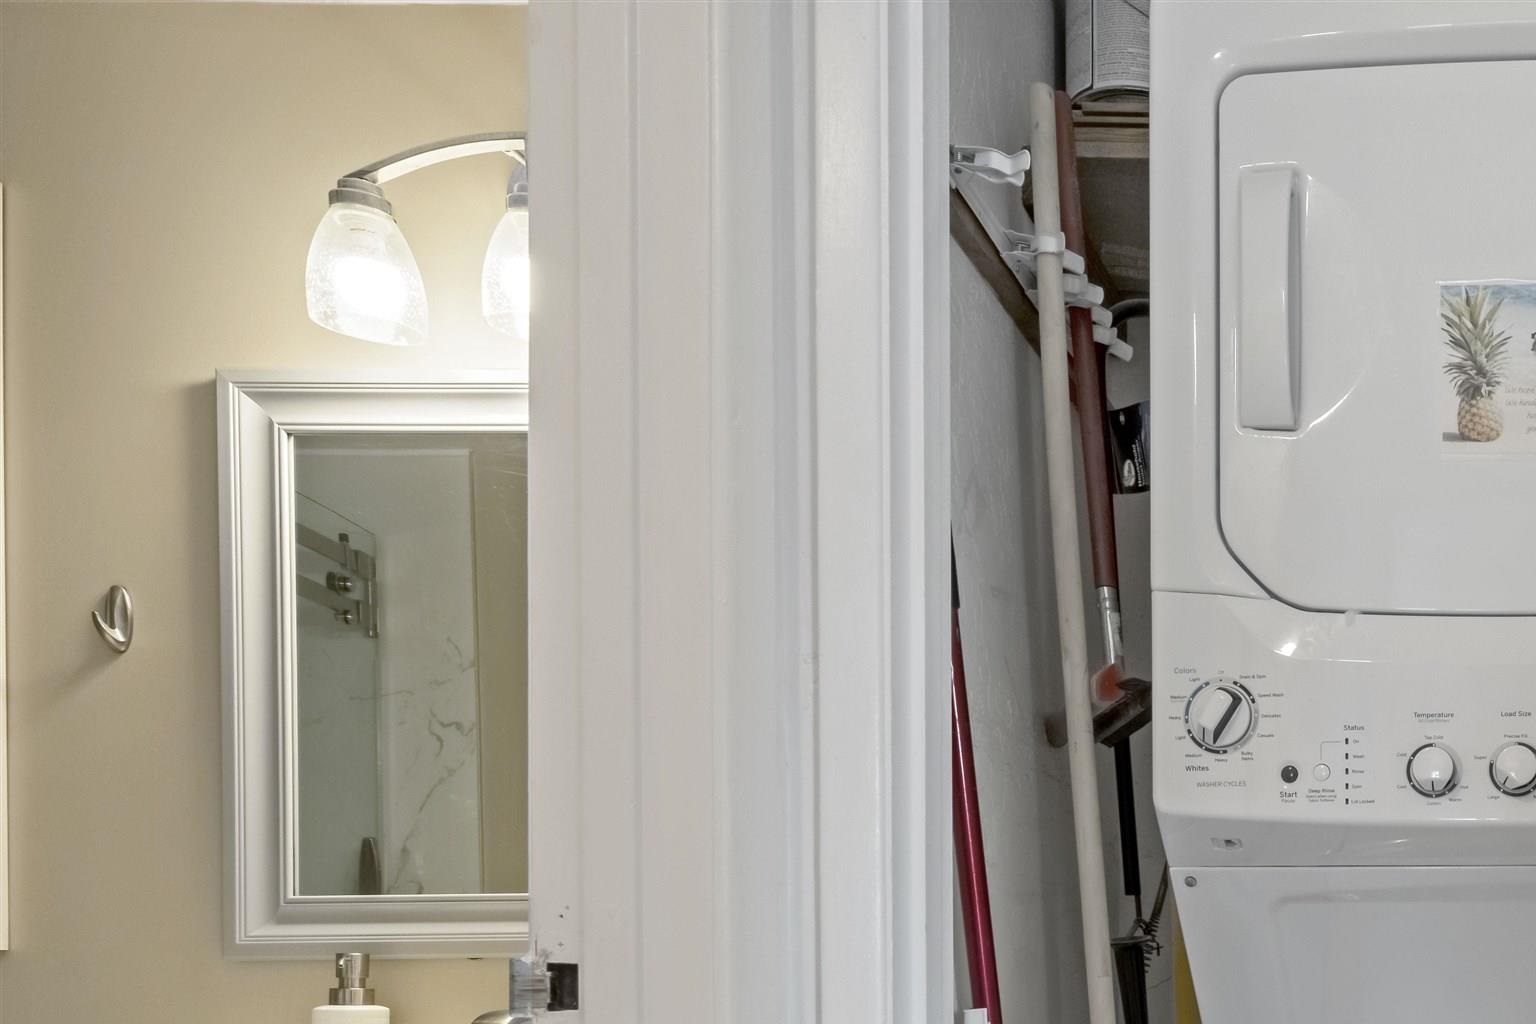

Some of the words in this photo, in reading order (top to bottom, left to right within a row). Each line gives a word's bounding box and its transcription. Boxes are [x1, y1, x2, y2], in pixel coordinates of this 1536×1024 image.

[1185, 765, 1210, 773] Whites
[1196, 780, 1223, 788] WASHER
[1223, 780, 1247, 788] CYCLES
